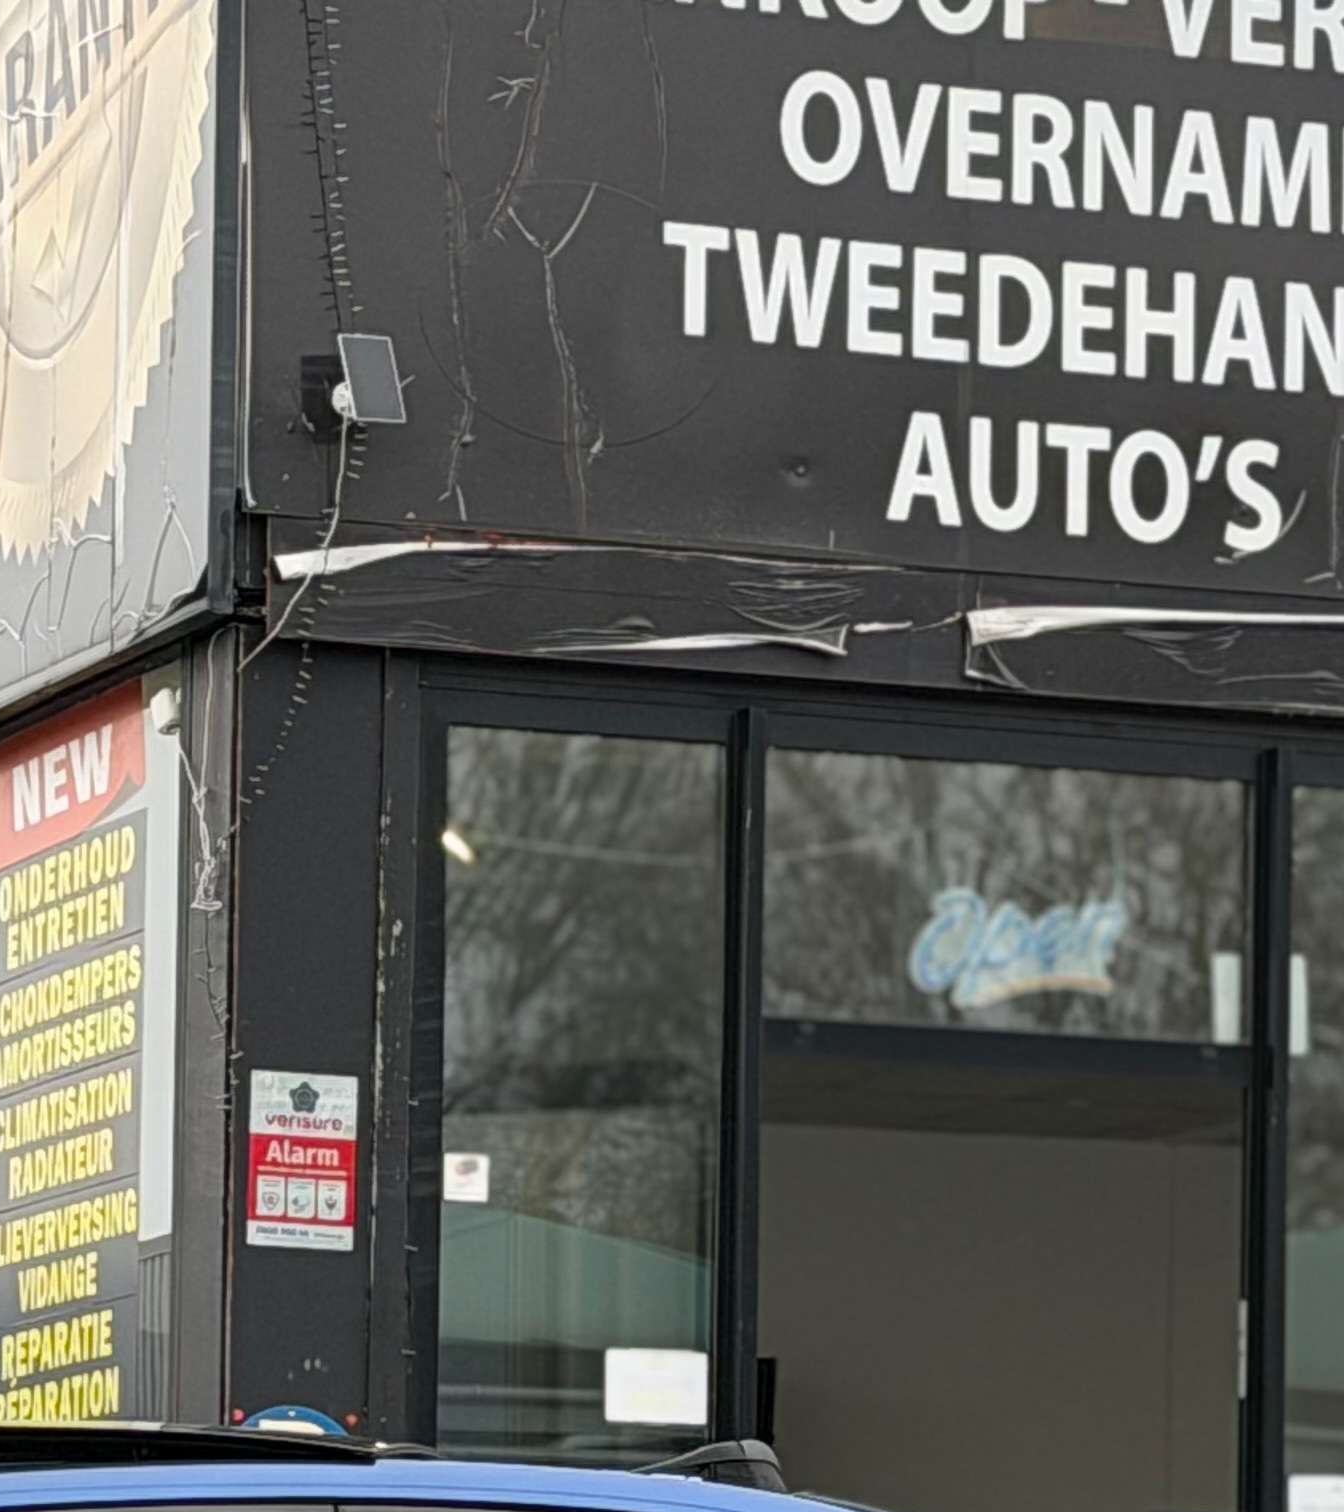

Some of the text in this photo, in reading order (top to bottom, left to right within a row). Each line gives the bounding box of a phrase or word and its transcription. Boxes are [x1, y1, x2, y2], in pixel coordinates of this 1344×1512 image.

[884, 410, 1285, 553] AUTO'S
[11, 724, 113, 832] NEW
[5, 881, 125, 971] ENTRETIEN
[909, 885, 1127, 1007] Open
[264, 1113, 344, 1132] verisure
[265, 1139, 340, 1168] Alarm
[8, 1128, 114, 1200] RADIATEUR
[17, 1251, 98, 1313] VIDANGE
[0, 1308, 113, 1381] REPARATIE
